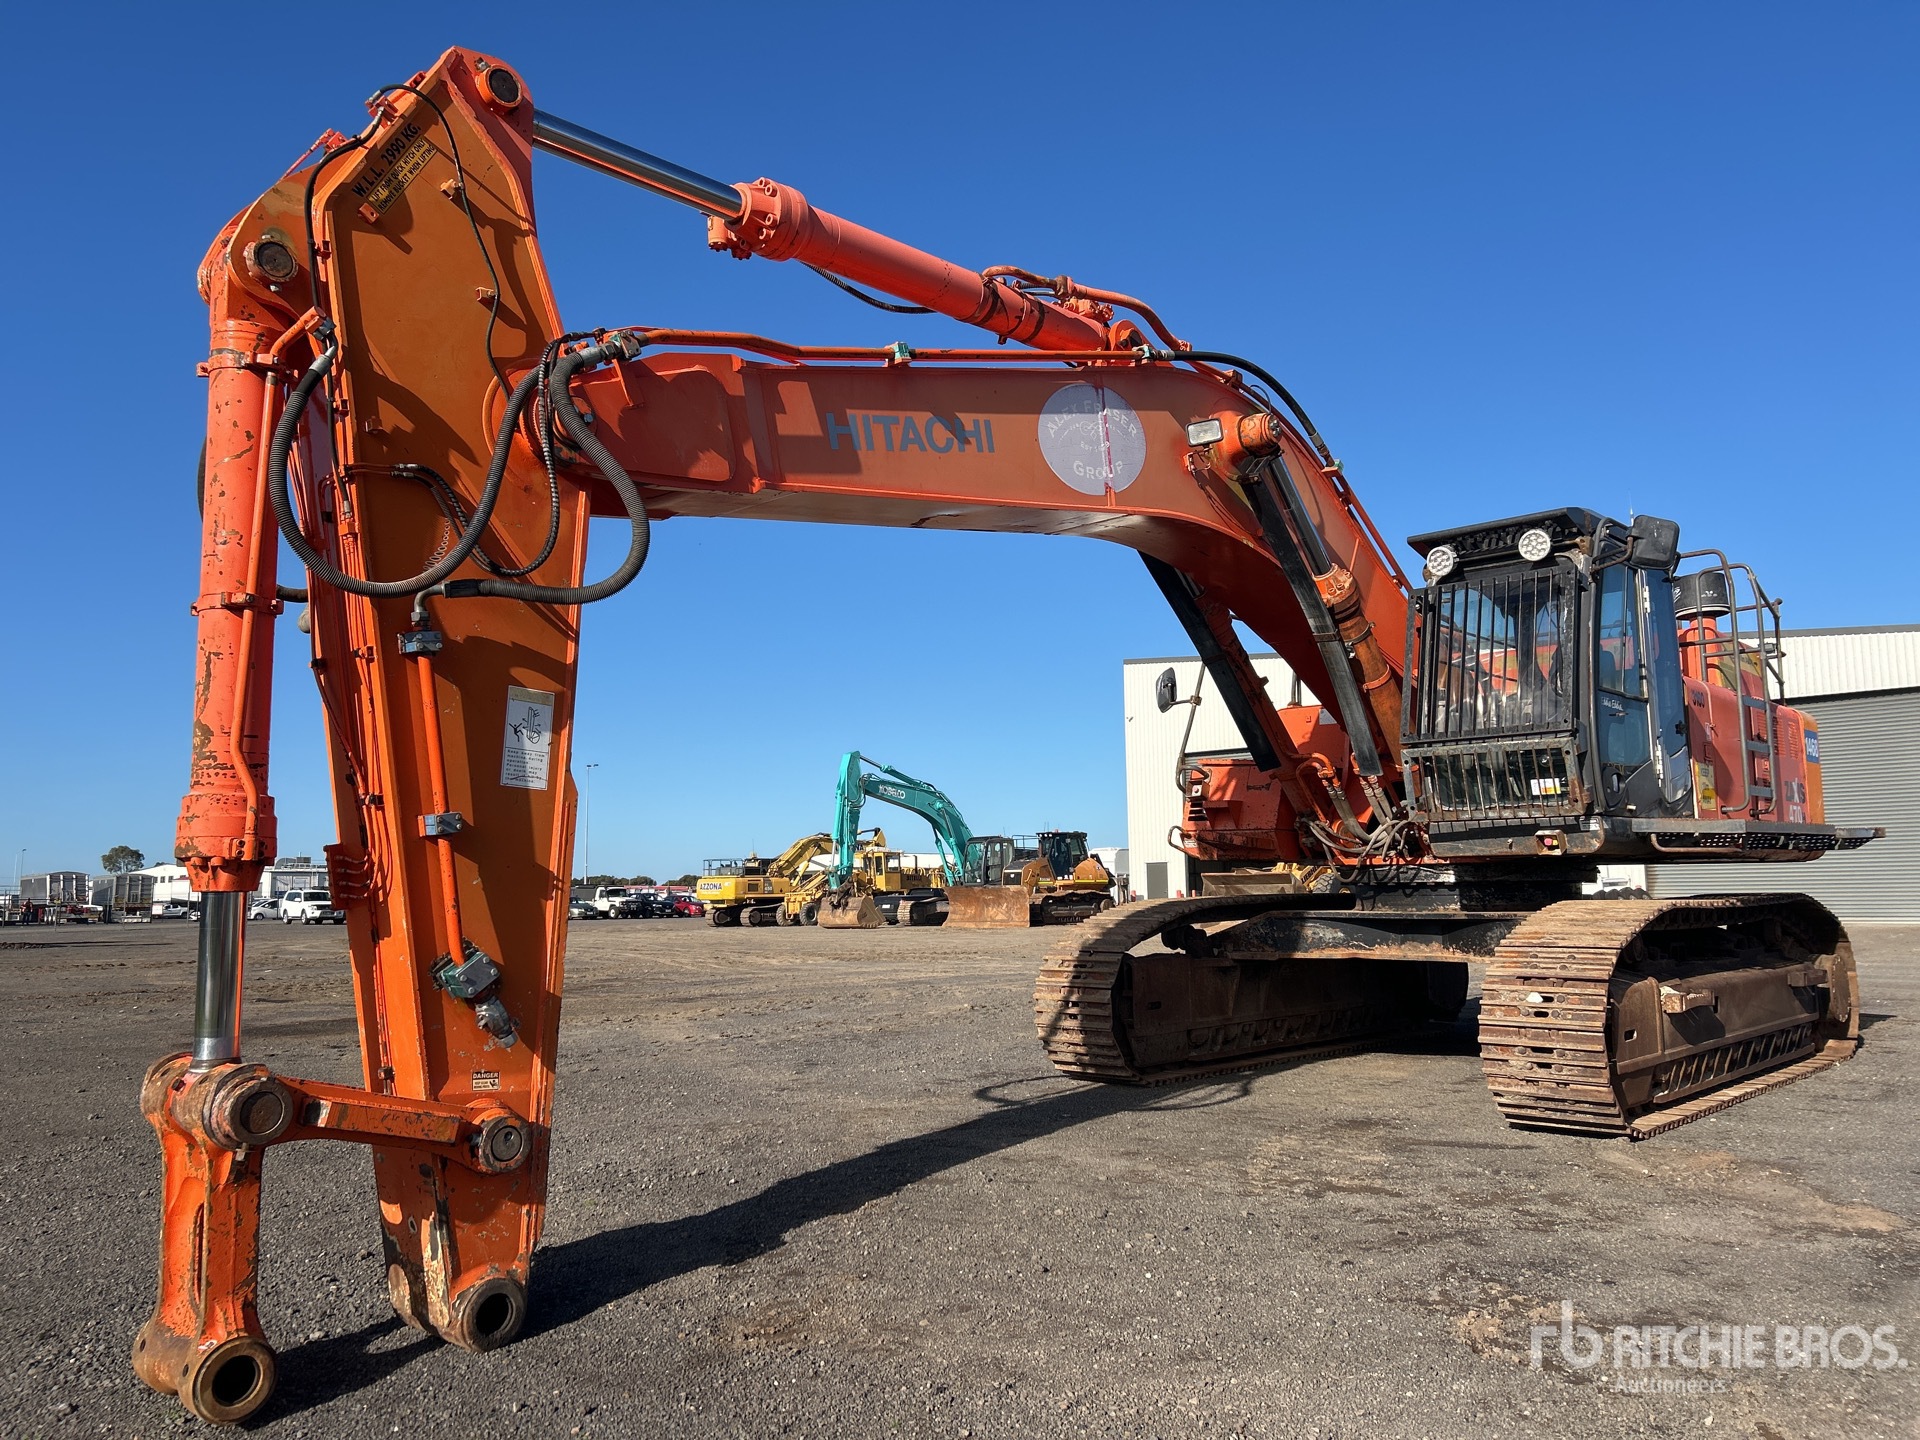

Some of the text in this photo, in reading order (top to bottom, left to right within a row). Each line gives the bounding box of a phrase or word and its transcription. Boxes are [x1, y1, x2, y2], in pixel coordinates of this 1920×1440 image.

[380, 138, 406, 165] 2990
[372, 139, 426, 201] LIFT FROM QUICK HITCH ONLY
[378, 144, 436, 210] REMOVE BUCKET WHEN LIFTING
[826, 412, 995, 454] HITACHI
[1073, 460, 1124, 480] GROUP
[879, 784, 905, 799] KOBELCO
